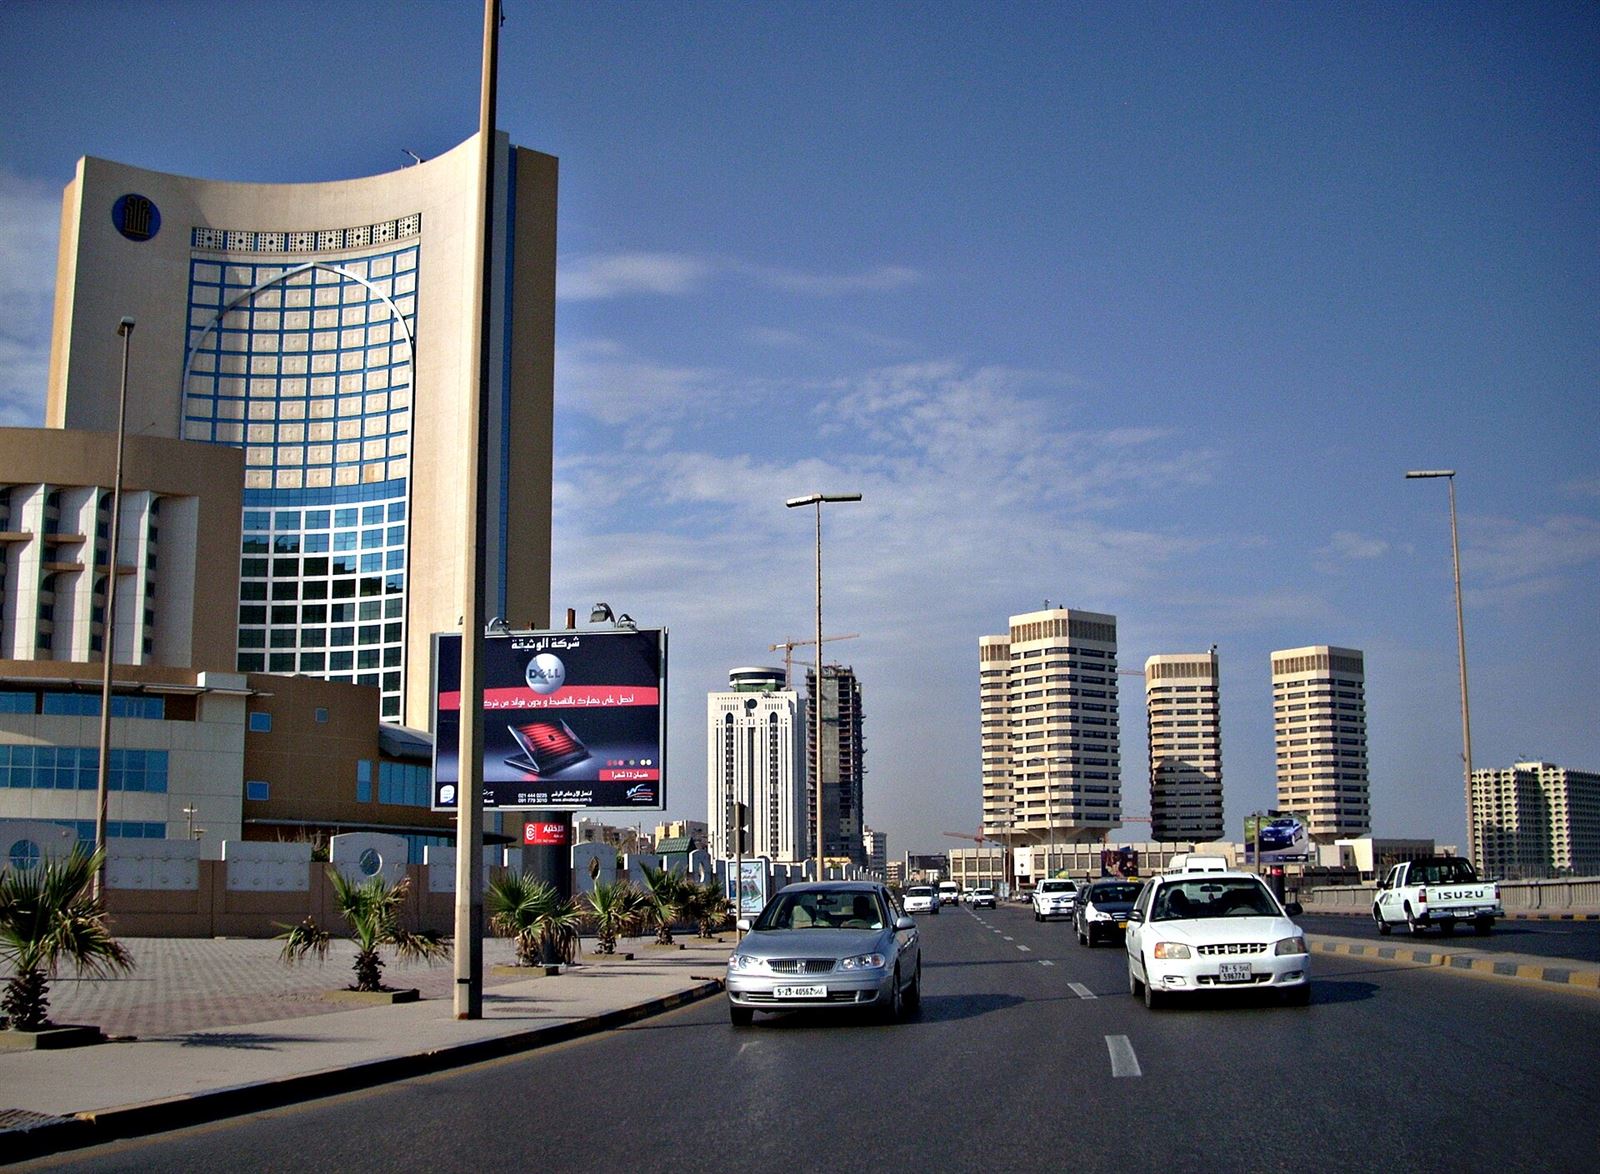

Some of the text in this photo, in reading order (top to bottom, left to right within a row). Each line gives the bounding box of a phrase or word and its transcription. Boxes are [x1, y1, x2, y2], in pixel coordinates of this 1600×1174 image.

[511, 636, 580, 652] شركة الوثيقة
[529, 668, 561, 679] DELL
[1438, 890, 1484, 900] ISUZU
